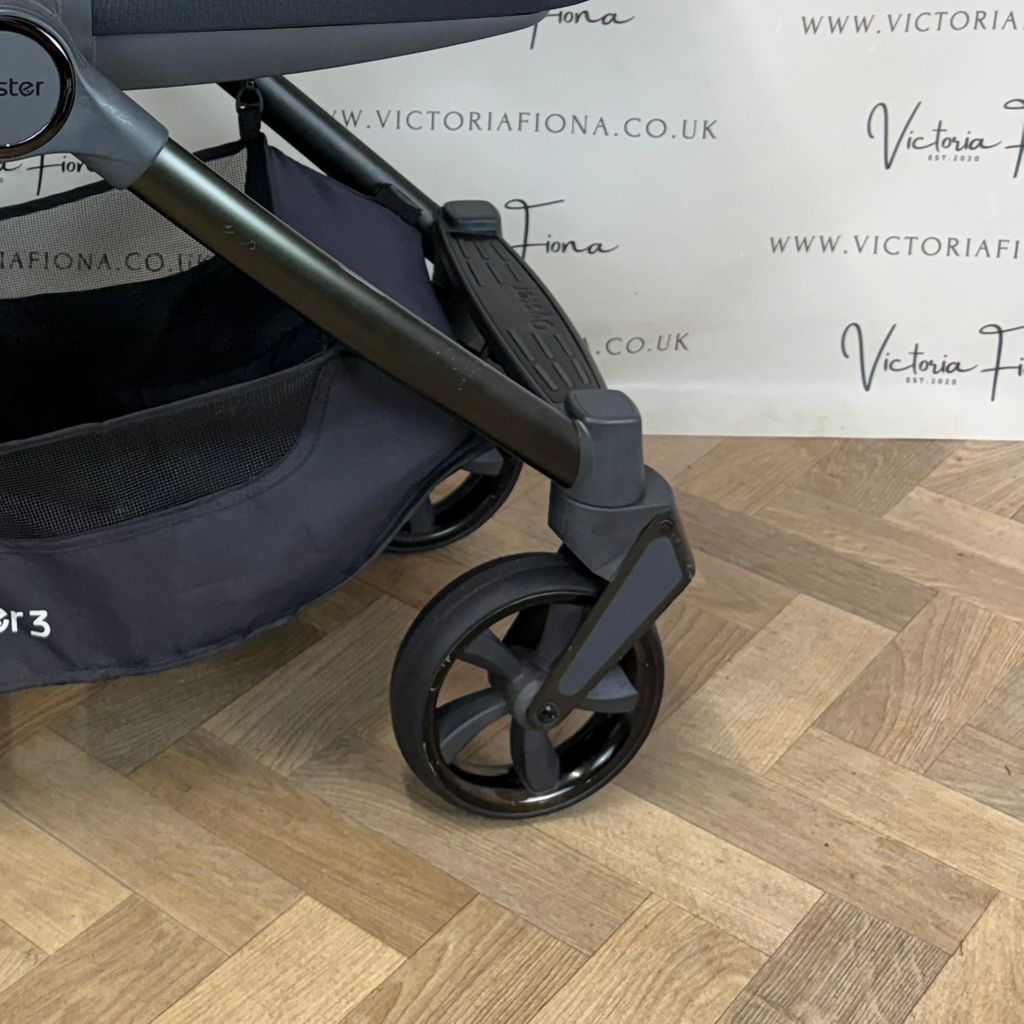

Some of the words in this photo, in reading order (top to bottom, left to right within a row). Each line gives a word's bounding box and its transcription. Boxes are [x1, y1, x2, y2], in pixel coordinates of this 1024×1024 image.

[332, 109, 718, 140] W.VICTORIAFIONA.CO.UK
[867, 101, 1002, 170] Victoria
[505, 199, 619, 259] Fiona
[841, 323, 977, 391] Victoria
